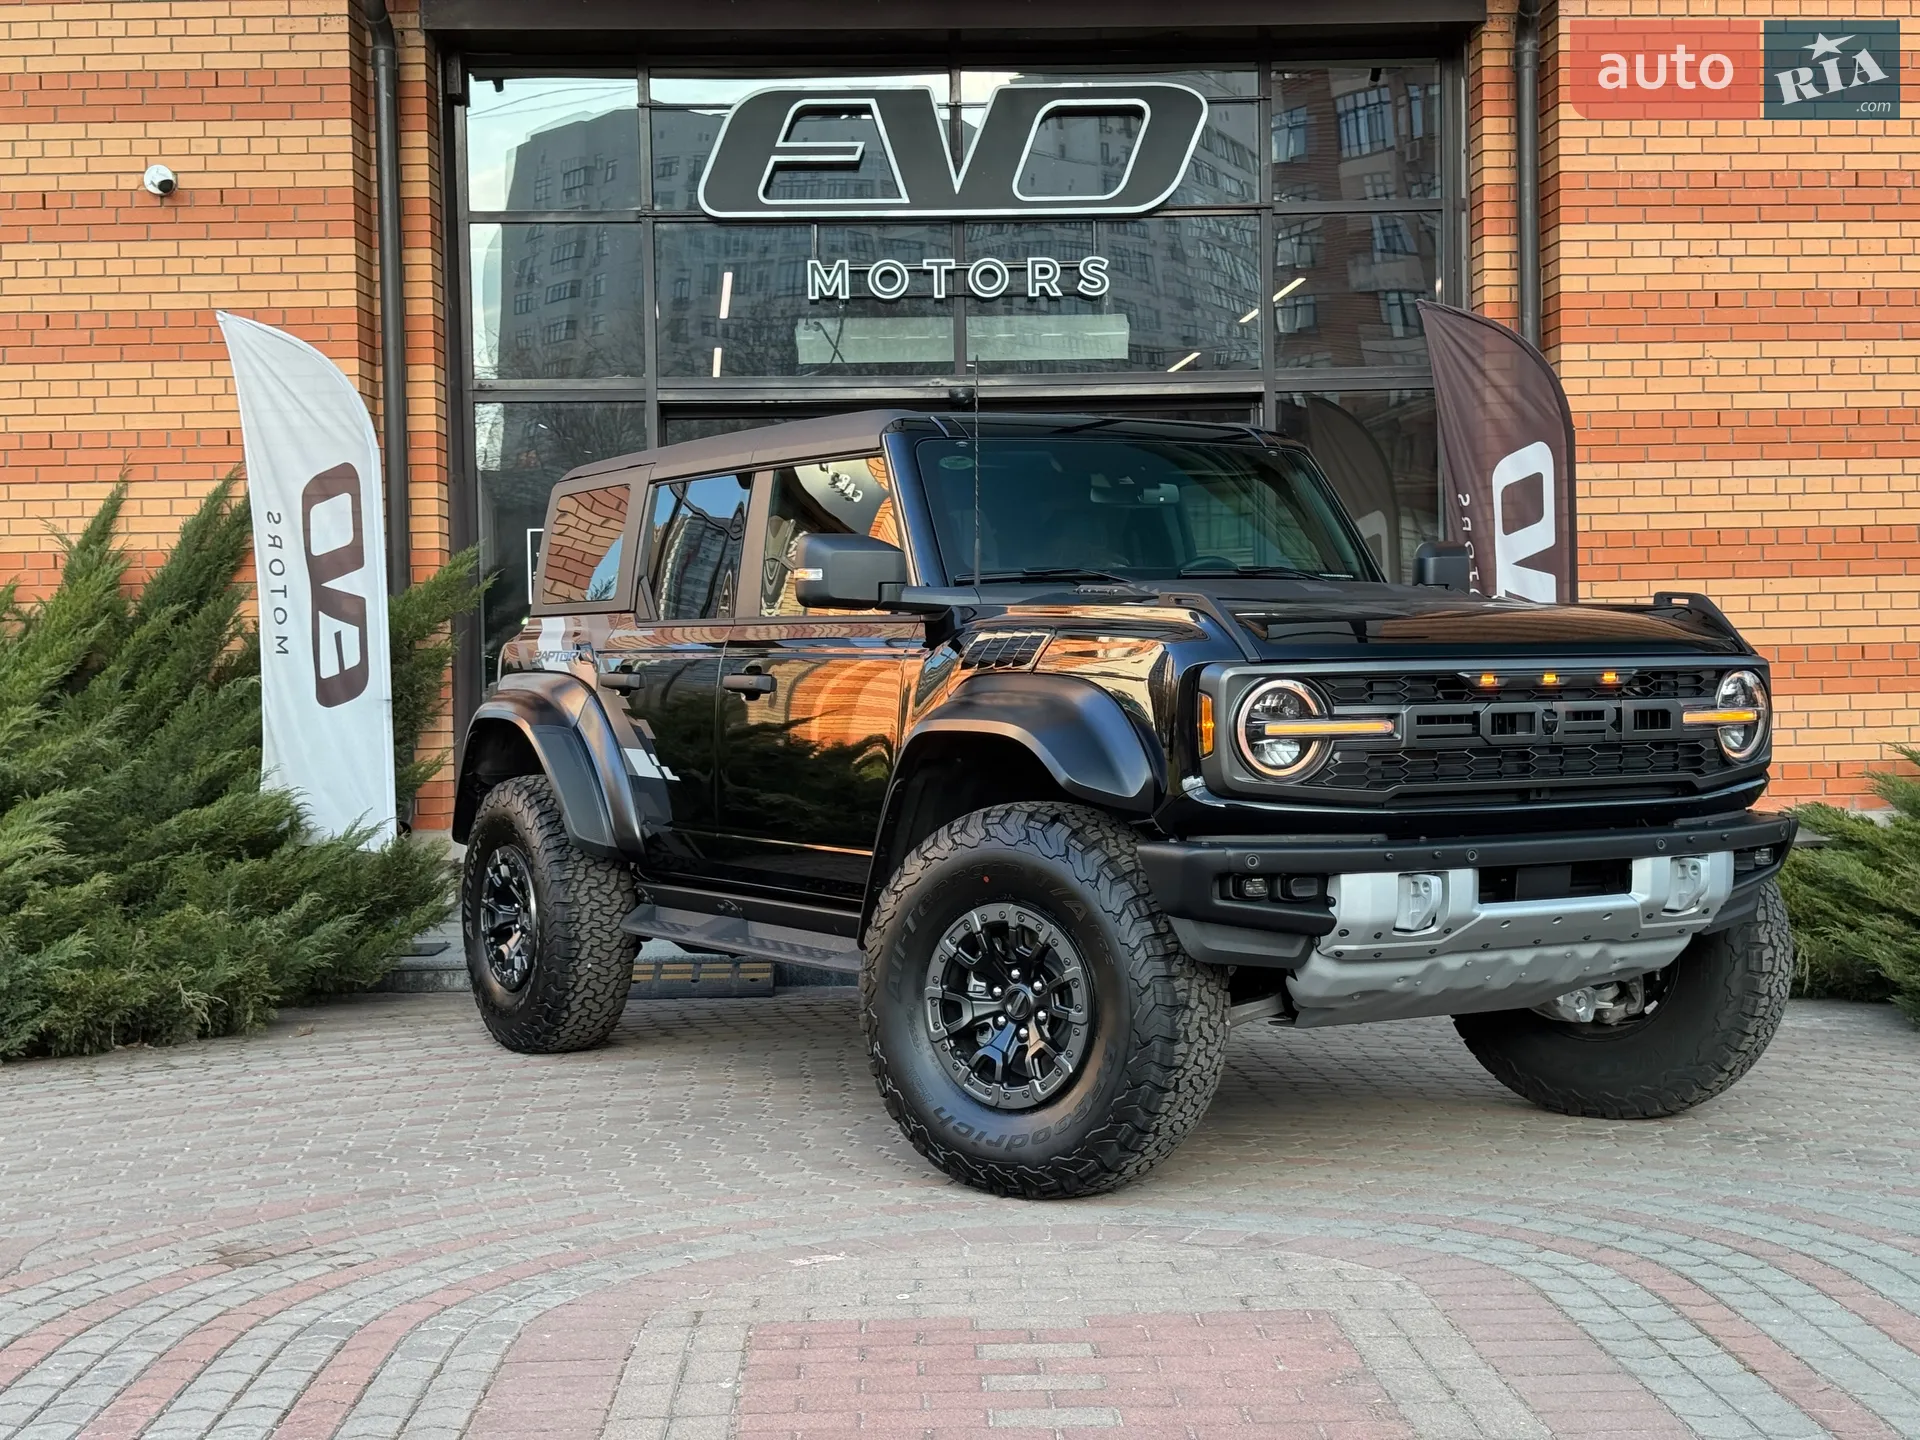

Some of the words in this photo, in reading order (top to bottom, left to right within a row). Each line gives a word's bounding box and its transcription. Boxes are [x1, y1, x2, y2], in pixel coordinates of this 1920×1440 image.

[698, 82, 1209, 219] EVO
[806, 256, 1110, 301] MOTORS
[1402, 699, 1683, 749] FORD
